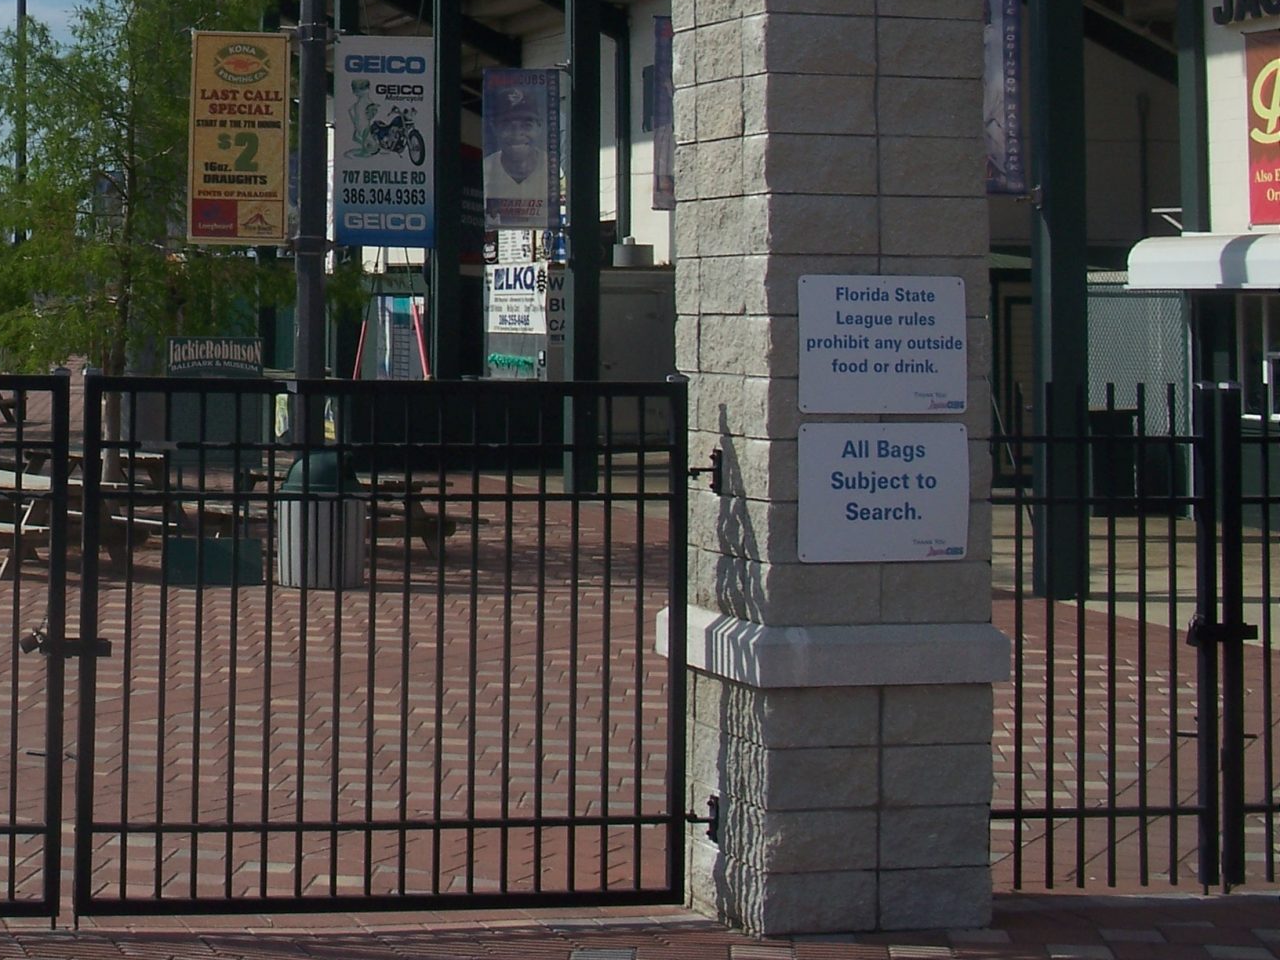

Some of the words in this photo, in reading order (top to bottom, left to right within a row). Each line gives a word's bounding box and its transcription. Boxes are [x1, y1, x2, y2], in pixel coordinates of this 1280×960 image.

[228, 45, 256, 55] KONA
[344, 55, 426, 74] GEICO
[200, 88, 239, 100] LAST
[243, 89, 283, 102] CALL
[375, 84, 424, 95] GEICO
[208, 103, 273, 115] SPECIAL
[203, 174, 268, 185] DRAUGHTS
[342, 170, 360, 184] 707
[363, 170, 408, 184] BEVILLE
[410, 171, 426, 185] RD
[1254, 169, 1273, 184] Also
[236, 190, 278, 198] PARADISE
[343, 188, 426, 205] 386.304.9363
[344, 212, 426, 231] GEICO
[505, 266, 535, 291] LKQ
[835, 287, 889, 302] Florida
[895, 287, 935, 302] State
[836, 311, 892, 328] League
[898, 312, 935, 326] rules
[806, 334, 869, 352] prohibit
[875, 339, 902, 352] any
[907, 336, 963, 350] outside
[171, 360, 213, 371] BALLPARK
[223, 361, 258, 372] MUSEUM
[831, 358, 868, 373] food
[873, 363, 889, 373] or
[894, 359, 938, 374] drink.
[841, 440, 869, 458] All
[877, 440, 926, 462] Bags
[831, 471, 910, 493] Subject
[916, 473, 937, 489] to
[845, 502, 922, 521] Search.
